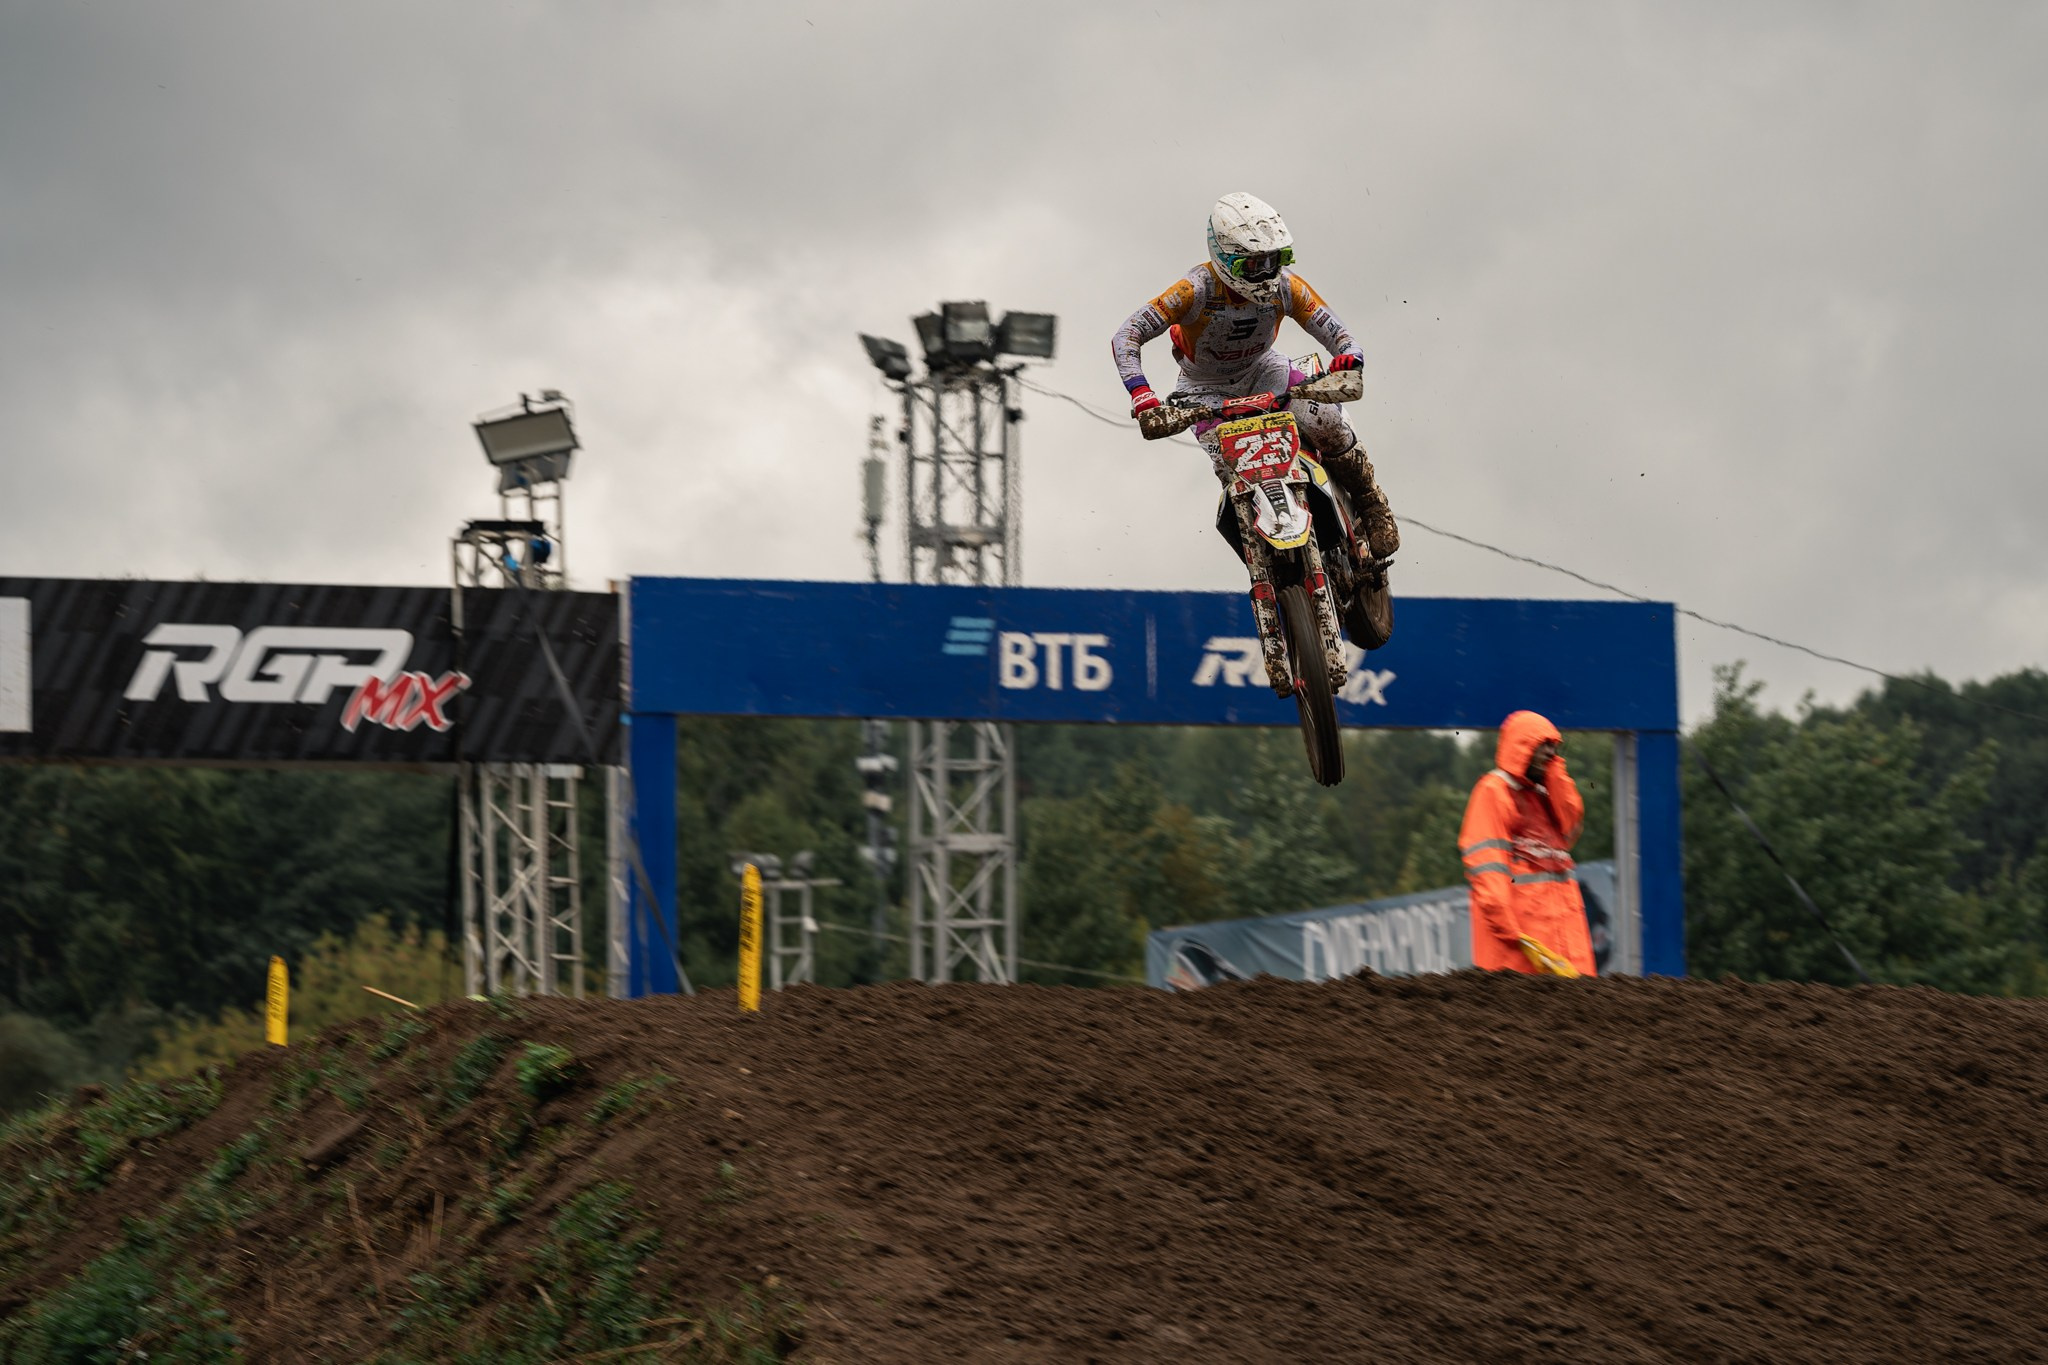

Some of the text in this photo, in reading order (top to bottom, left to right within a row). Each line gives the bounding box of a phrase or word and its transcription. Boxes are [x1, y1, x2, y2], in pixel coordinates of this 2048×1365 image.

[123, 623, 472, 733] RGP MX
[999, 631, 1114, 691] ВТБ
